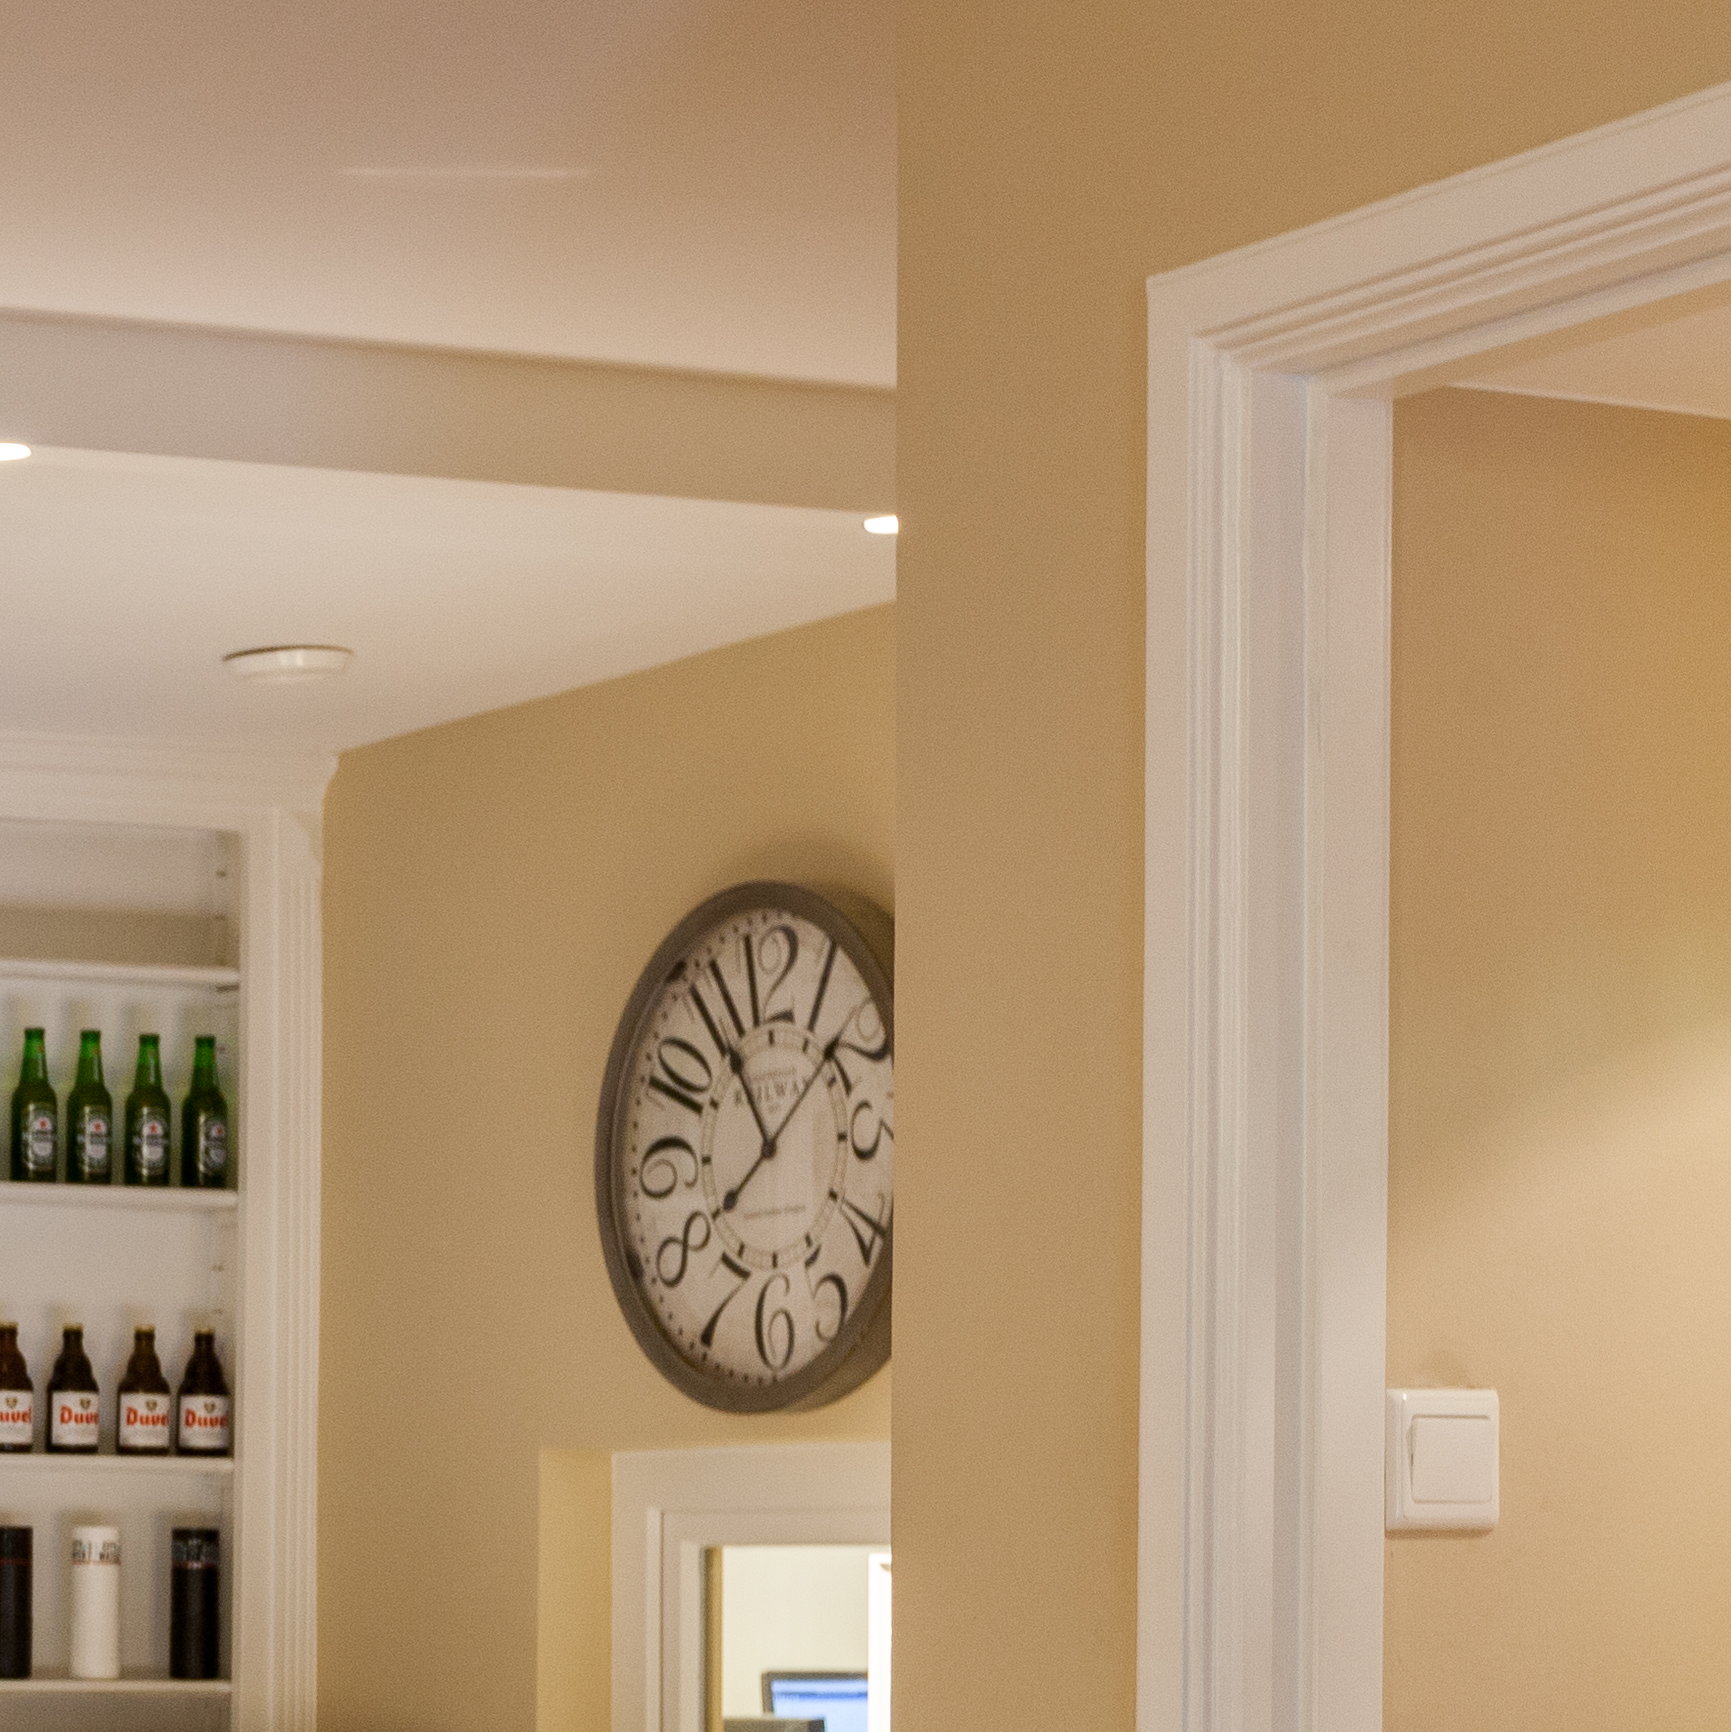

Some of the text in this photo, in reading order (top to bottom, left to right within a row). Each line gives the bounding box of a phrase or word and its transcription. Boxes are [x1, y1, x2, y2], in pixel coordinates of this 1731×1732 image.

[742, 922, 799, 1028] 12
[647, 1036, 714, 1115] 10
[640, 1136, 699, 1198] 9
[656, 1211, 711, 1288] 8
[700, 1251, 752, 1349] 7
[754, 1272, 796, 1371] 6
